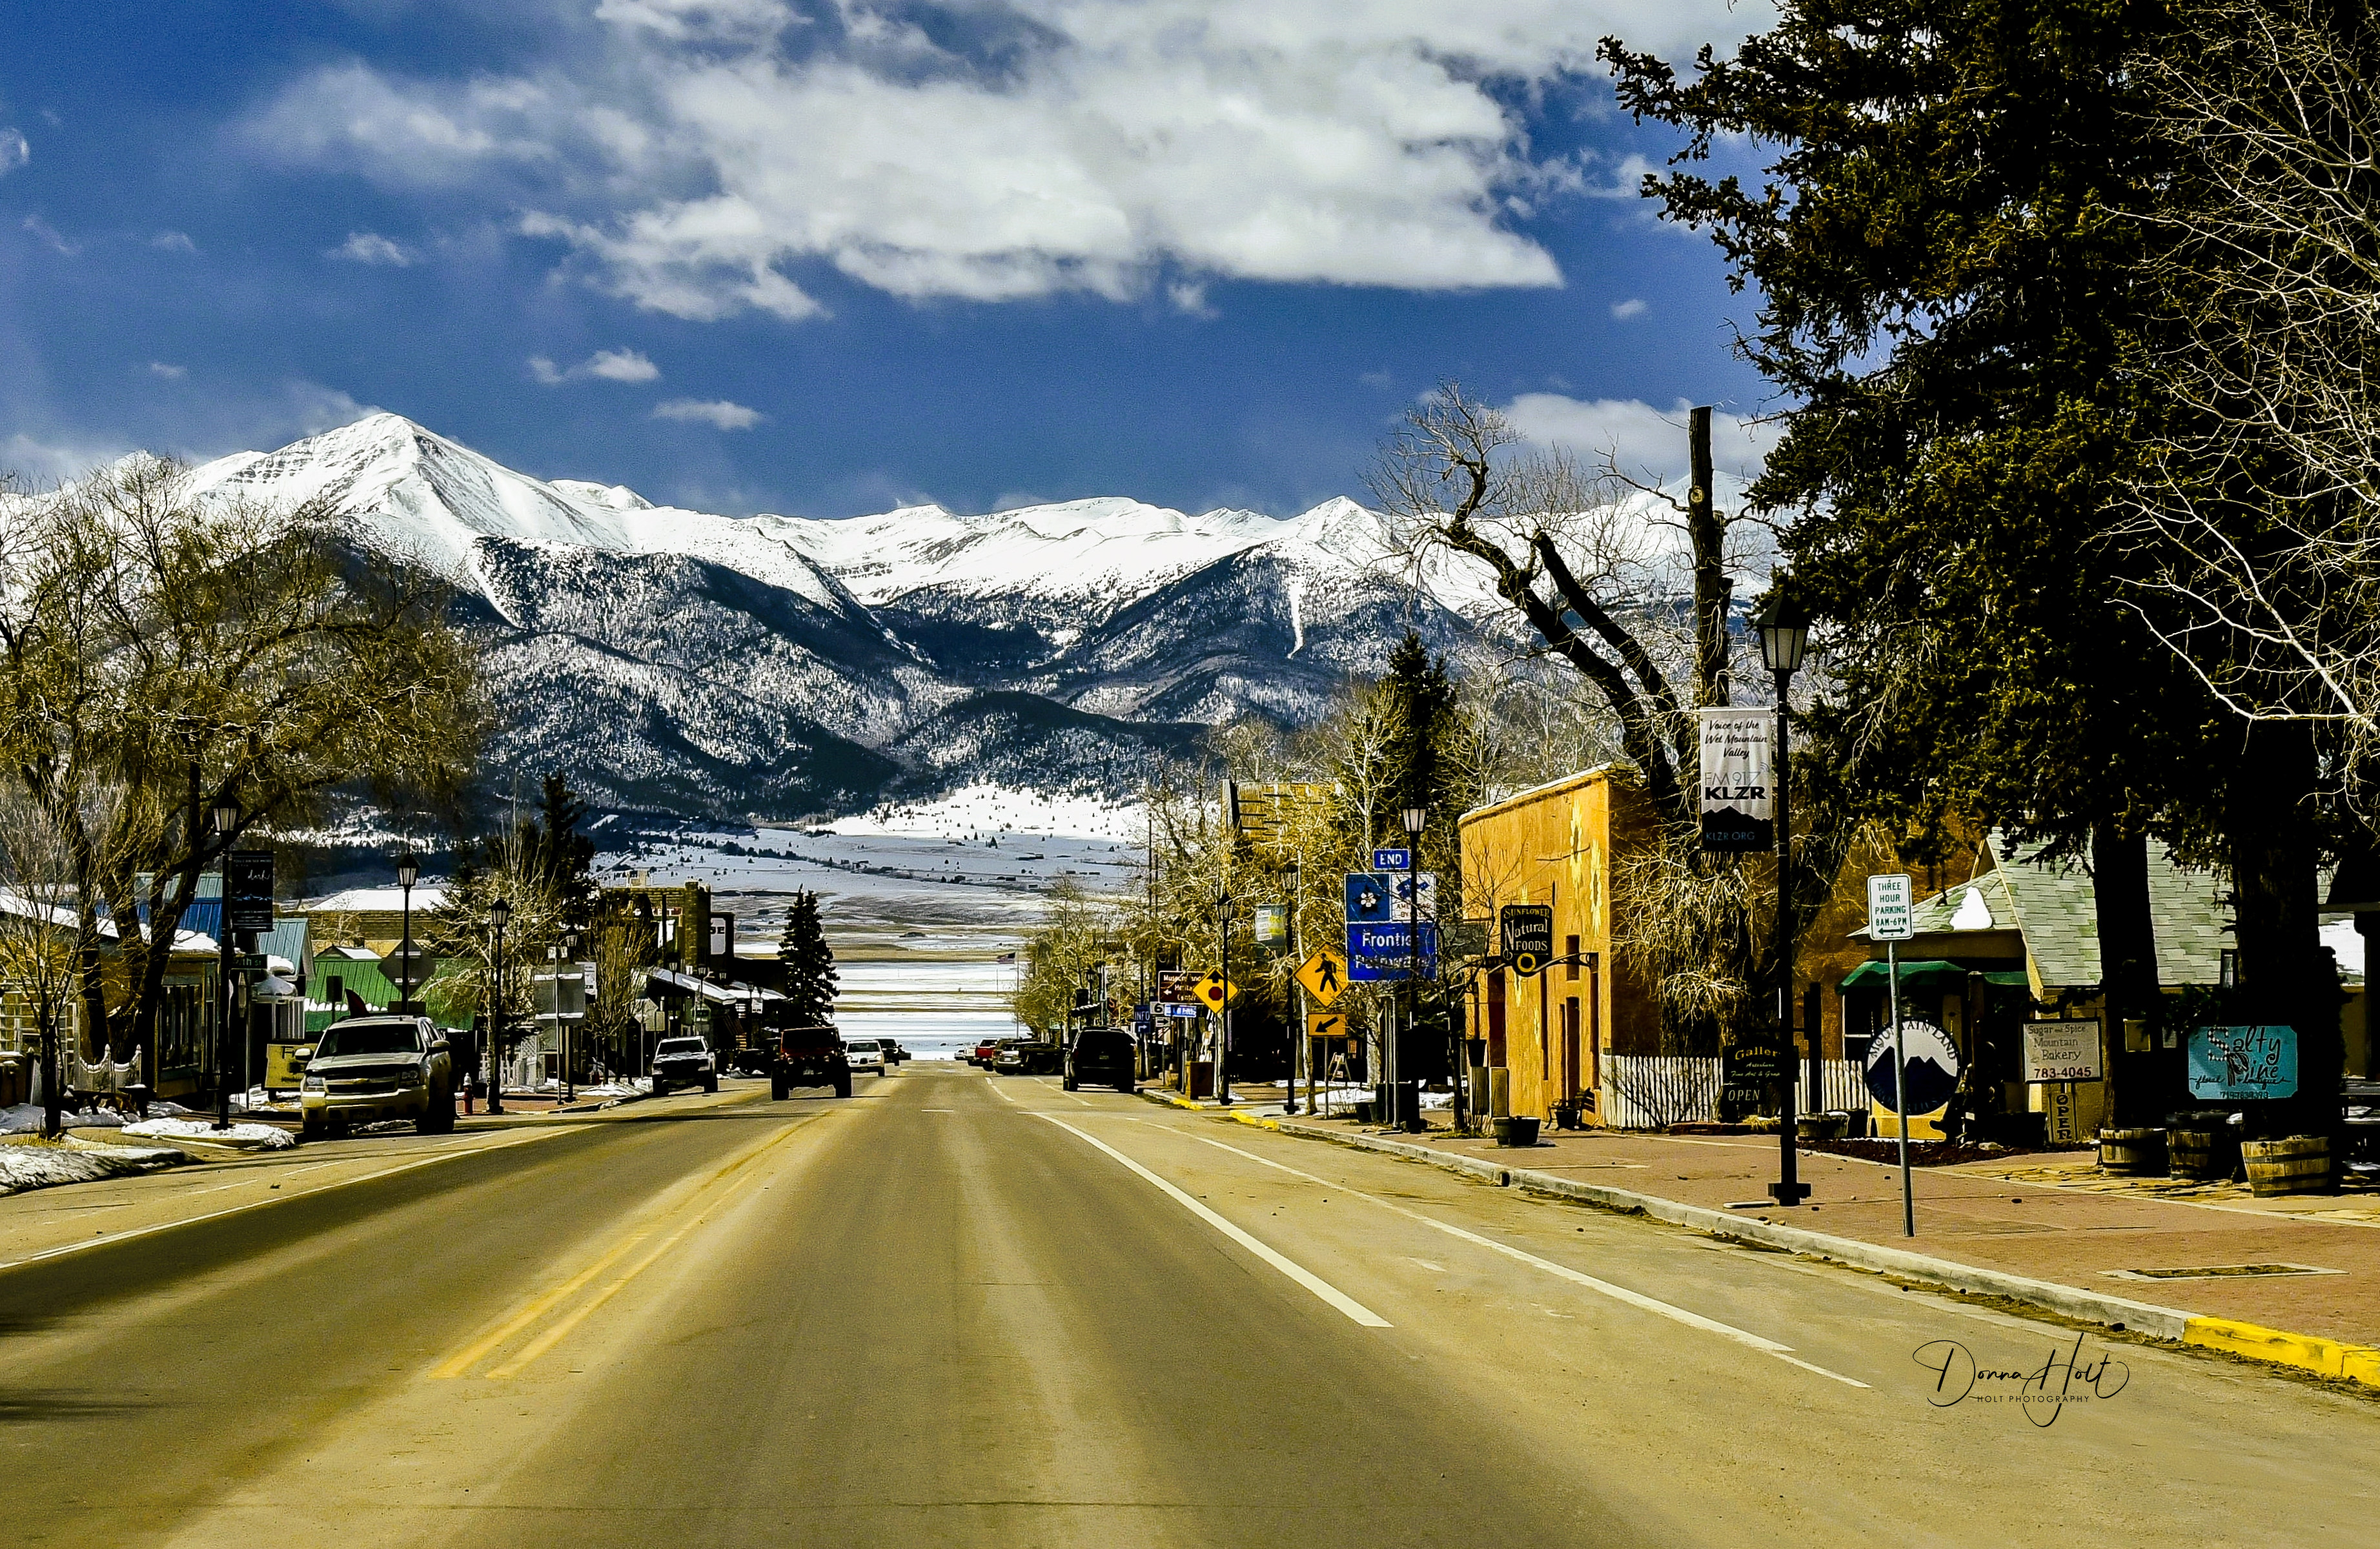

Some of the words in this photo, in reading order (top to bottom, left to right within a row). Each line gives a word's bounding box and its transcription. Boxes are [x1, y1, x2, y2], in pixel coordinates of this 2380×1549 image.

[1709, 720, 1731, 730] Voice
[1734, 722, 1743, 732] of
[1745, 720, 1759, 729] the
[1705, 734, 1723, 744] Wet
[1724, 734, 1767, 744] Mountain
[1723, 747, 1749, 759] Valley
[1705, 772, 1730, 785] FM
[1705, 786, 1767, 800] KLZR
[1380, 854, 1402, 865] END
[1877, 882, 1902, 891] THREE
[1880, 894, 1901, 903] HOUR
[1503, 908, 1550, 919] SUNFLOWER
[1875, 906, 1906, 915] PARKING
[1875, 917, 1907, 927] 8AM-6PM
[1363, 933, 1419, 947] Frontie
[1503, 918, 1549, 960] Natural
[1516, 940, 1548, 951] FOODS
[1134, 1011, 1150, 1020] INFO
[2028, 1025, 2053, 1037] Sugar
[2064, 1024, 2086, 1034] Spice
[2033, 1037, 2079, 1048] Mountain
[2206, 1026, 2281, 1066] Salty
[1734, 1046, 1781, 1060] Galler
[2040, 1049, 2082, 1062] Bakery
[2034, 1066, 2092, 1078] 783-4045
[1728, 1089, 1760, 1101] OPEN
